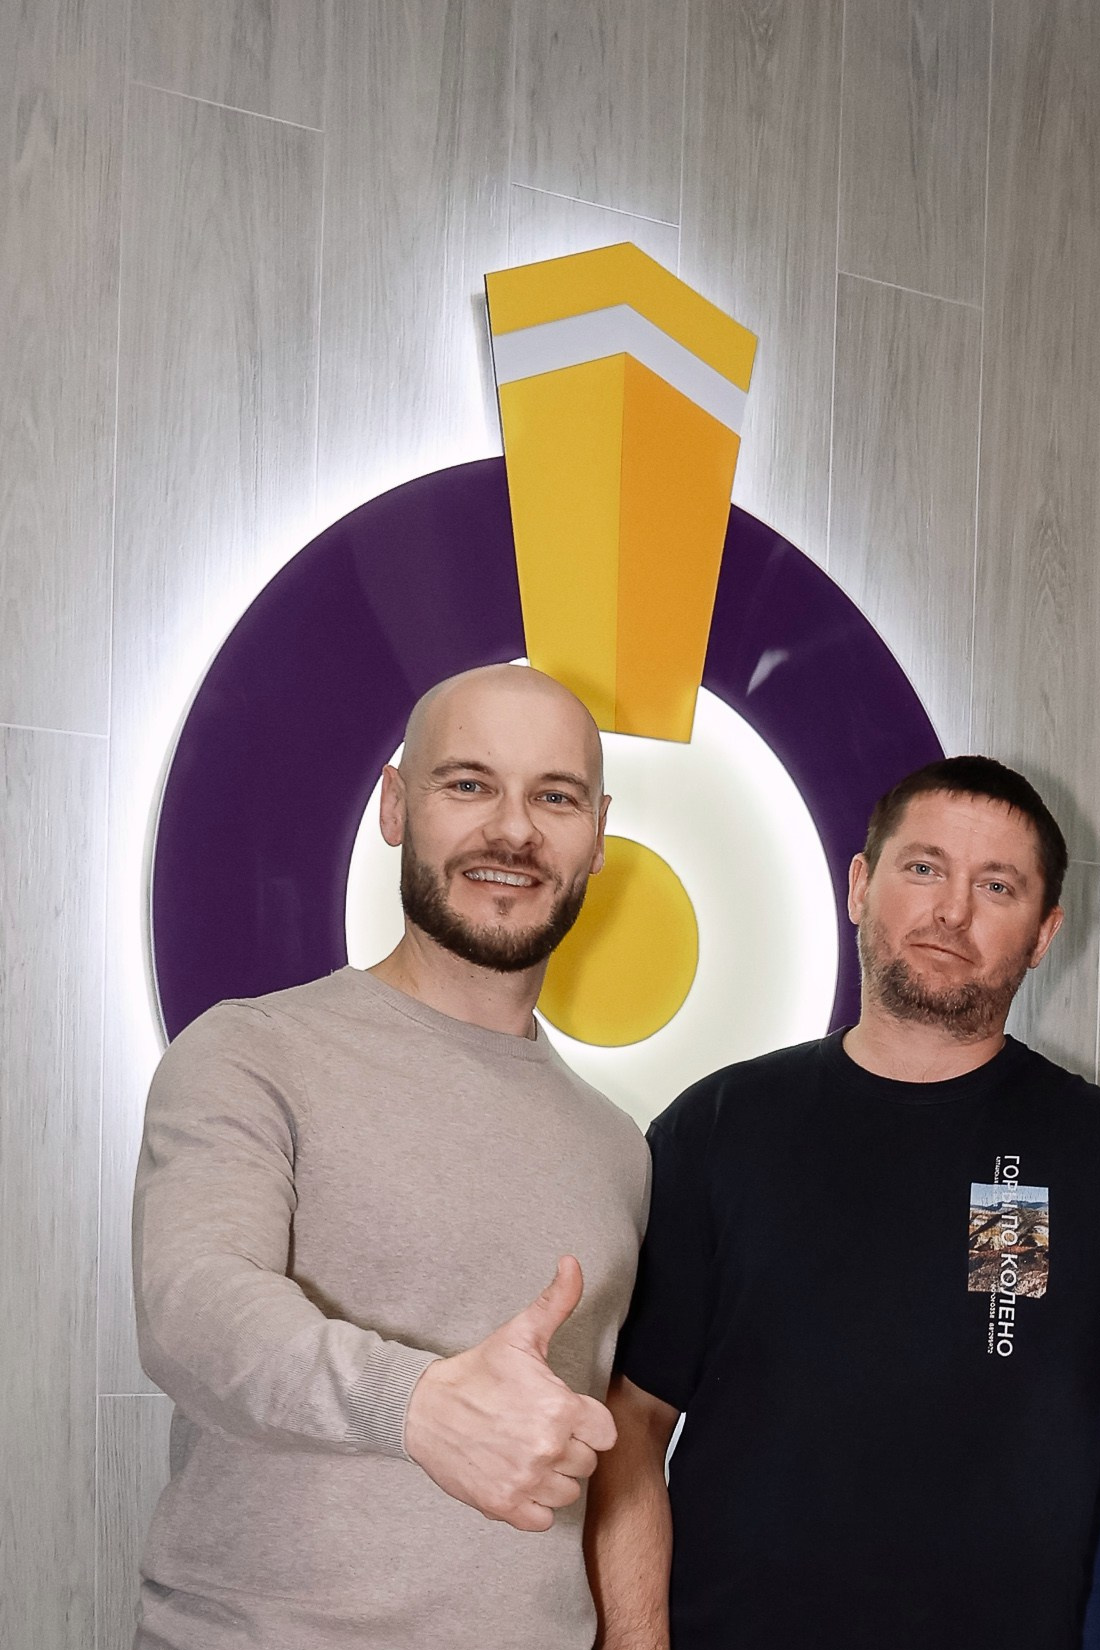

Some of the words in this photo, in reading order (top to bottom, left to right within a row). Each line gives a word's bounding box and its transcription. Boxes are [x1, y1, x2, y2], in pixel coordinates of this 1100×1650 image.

[1001, 1155, 1020, 1208] ГОРЫ
[1000, 1214, 1019, 1246] ПО
[996, 1253, 1018, 1357] КОЛЕНО
